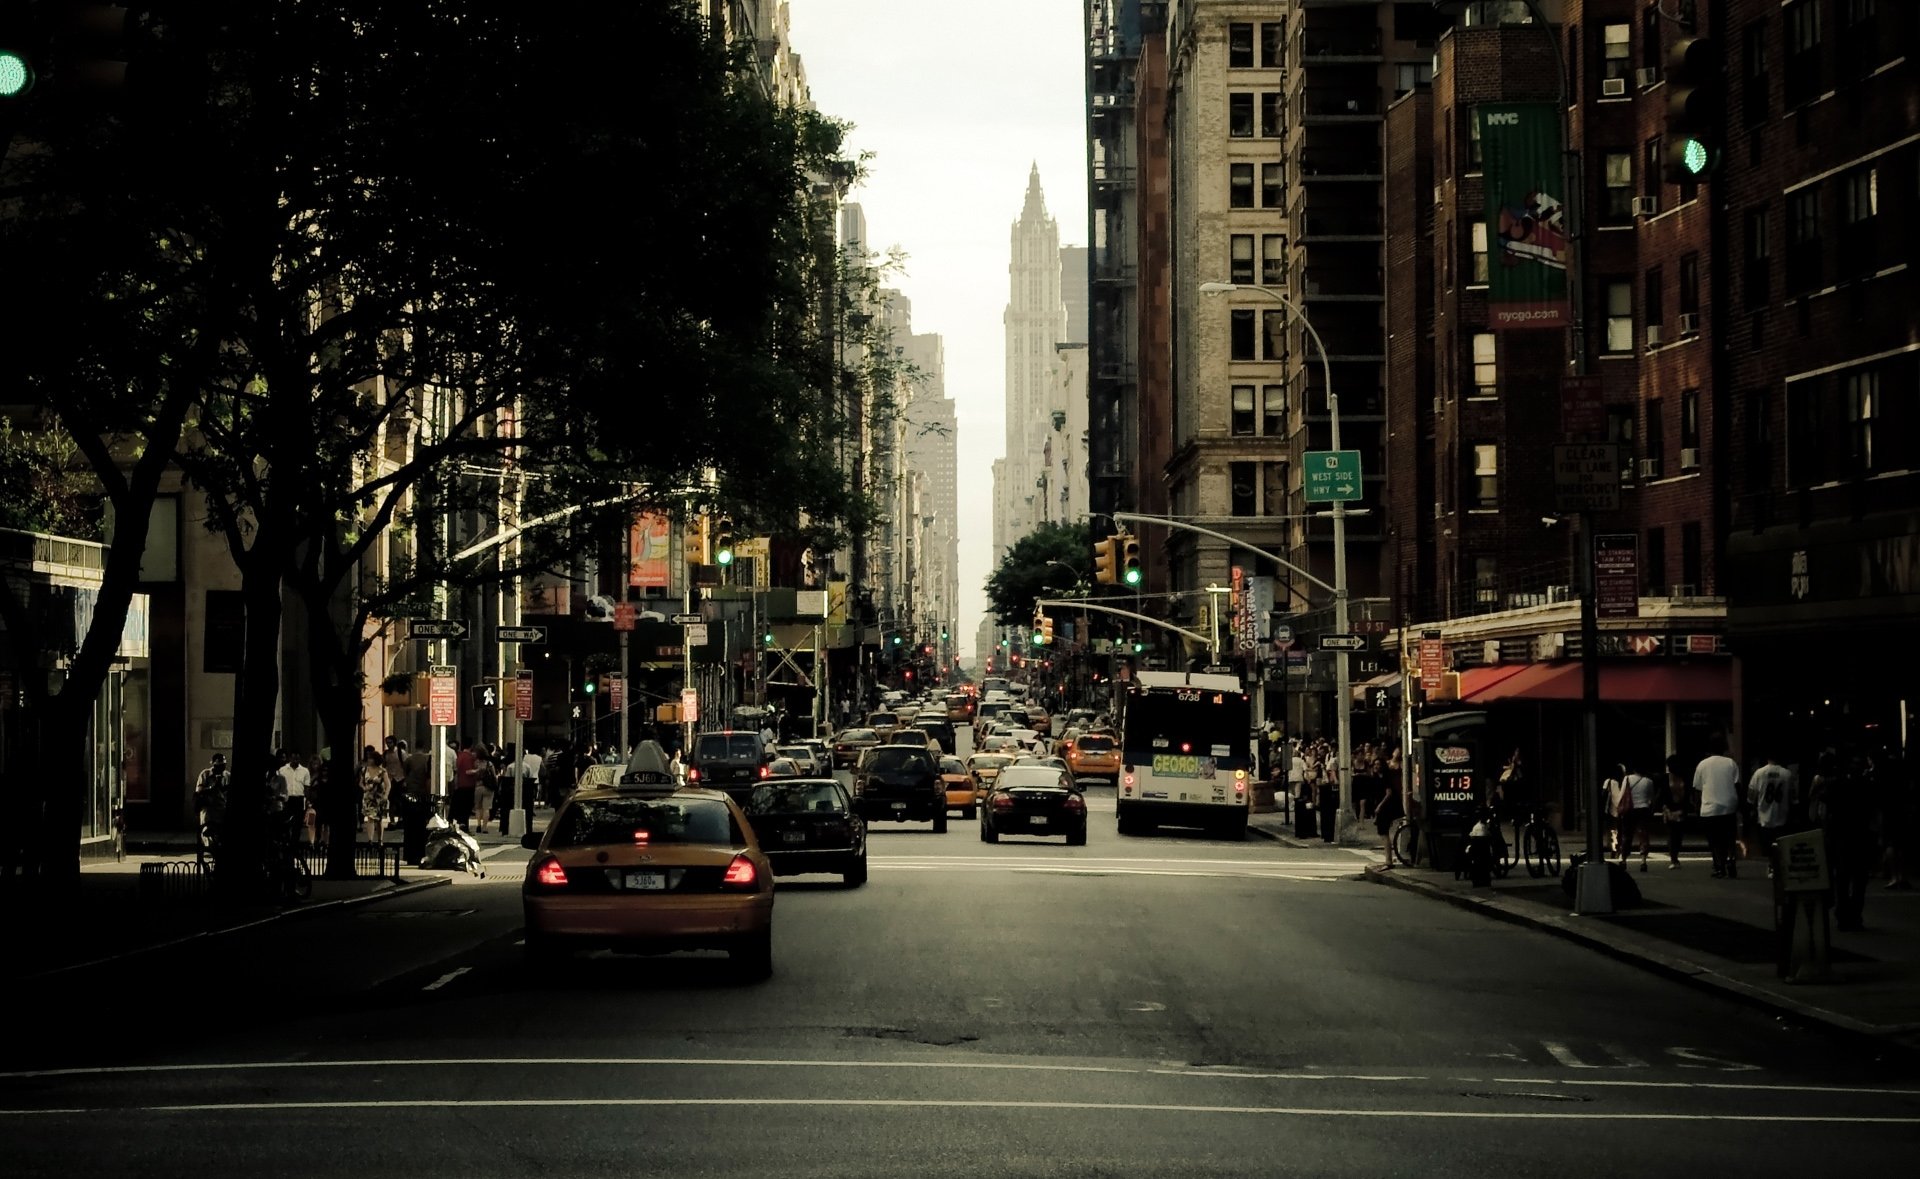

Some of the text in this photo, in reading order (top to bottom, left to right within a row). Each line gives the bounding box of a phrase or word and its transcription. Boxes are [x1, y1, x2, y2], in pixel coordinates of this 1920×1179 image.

[1487, 113, 1519, 126] NYC
[1498, 308, 1559, 323] nycgo.com
[1566, 448, 1605, 460] CLEAR
[1560, 462, 1612, 473] FIRE LANE
[1312, 471, 1353, 481] WEST SIDE
[1313, 485, 1330, 495] HWY
[1553, 483, 1617, 495] EMERGENCY
[1354, 621, 1384, 632] E 9 ST
[1178, 692, 1200, 702] 6738
[633, 773, 657, 783] 5J60
[1434, 775, 1471, 790] $ 113
[1434, 792, 1474, 801] MILLION
[1766, 782, 1783, 804] 86
